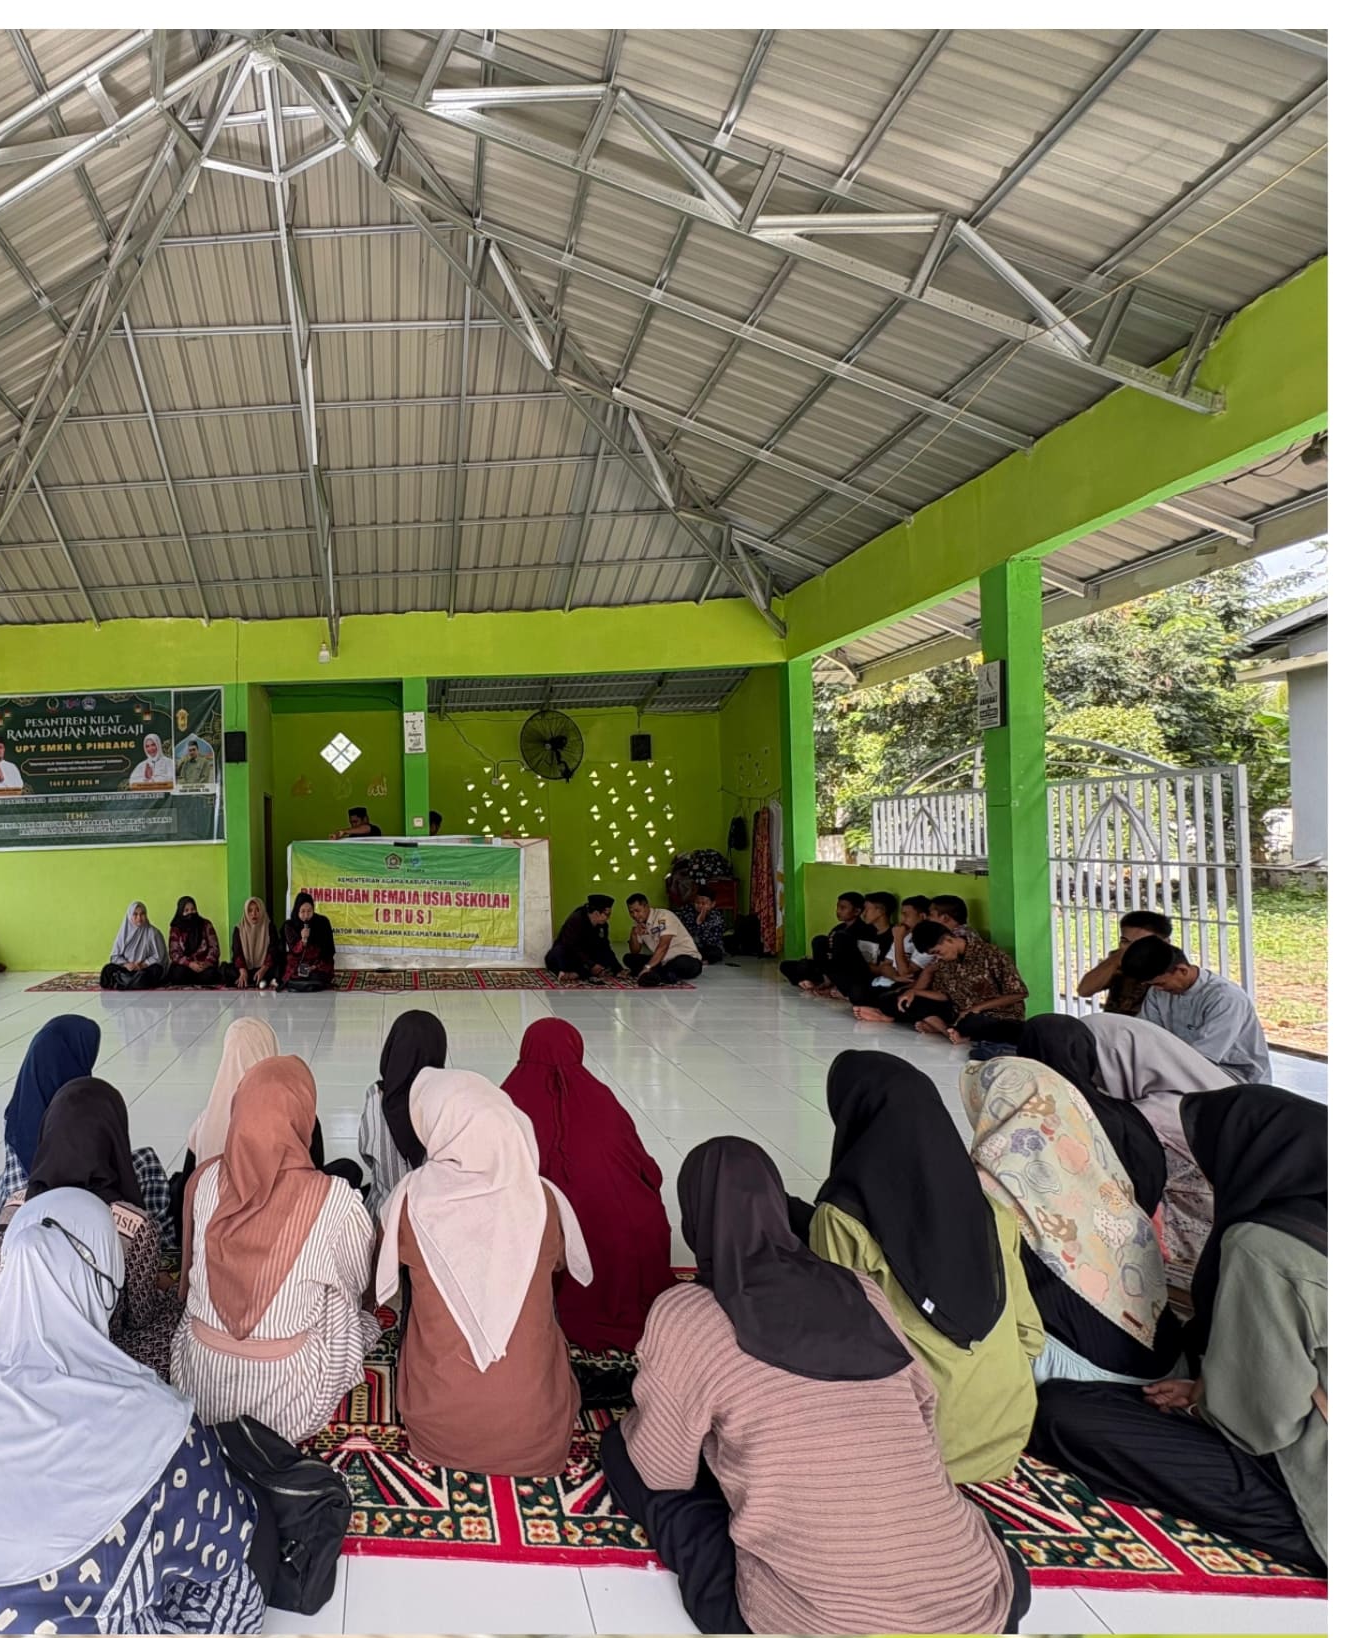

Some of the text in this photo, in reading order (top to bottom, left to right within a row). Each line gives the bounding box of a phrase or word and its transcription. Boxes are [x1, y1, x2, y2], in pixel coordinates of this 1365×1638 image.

[25, 714, 122, 729] PESANTREN KILAT
[88, 724, 145, 738] MENGAJI
[15, 744, 37, 753] UPT
[40, 743, 72, 752] SMKN
[86, 740, 137, 751] PINRANG
[373, 888, 421, 906] REMAJA
[422, 890, 452, 907] USIA
[455, 891, 510, 909] SEKOLAH
